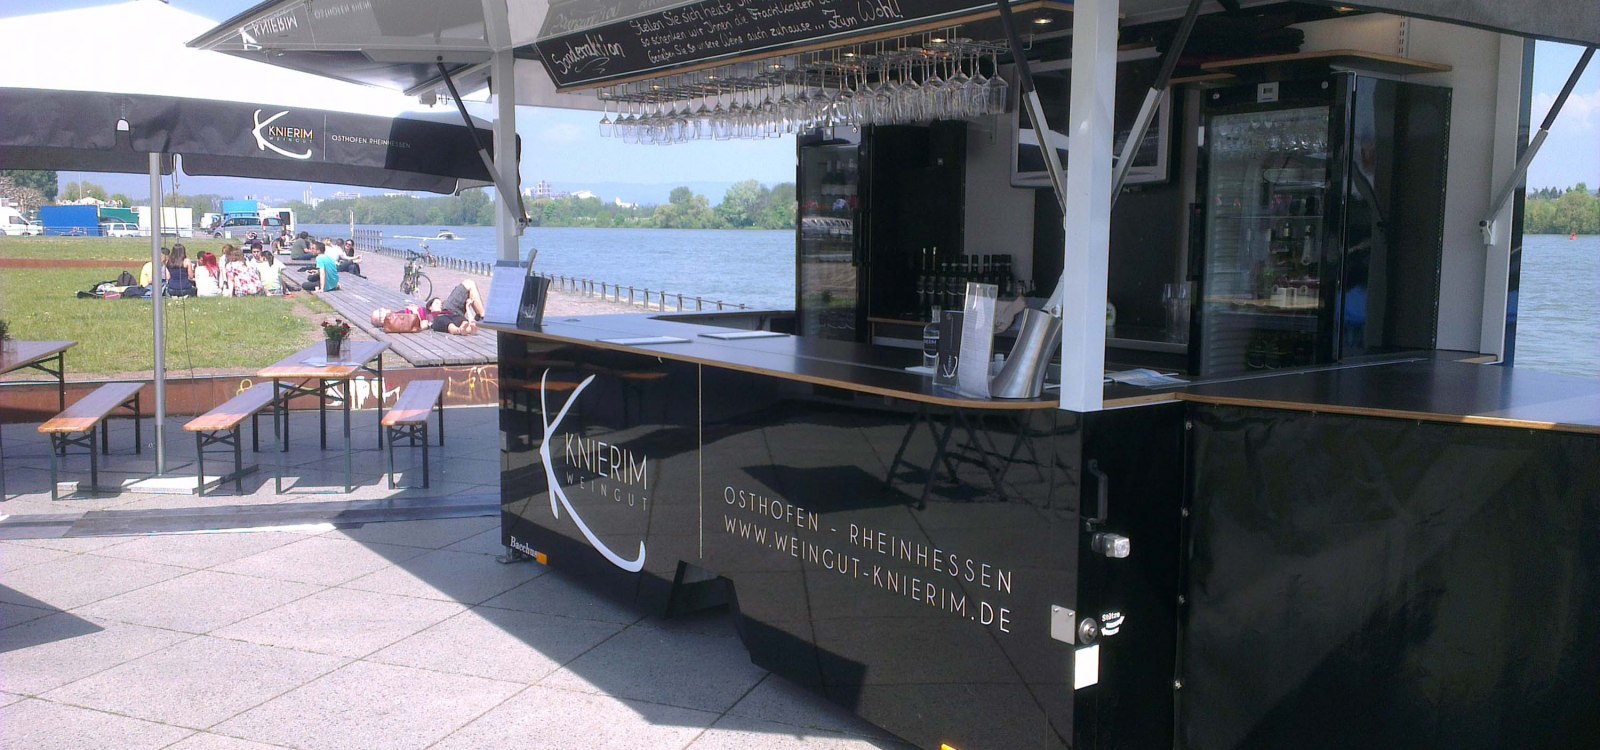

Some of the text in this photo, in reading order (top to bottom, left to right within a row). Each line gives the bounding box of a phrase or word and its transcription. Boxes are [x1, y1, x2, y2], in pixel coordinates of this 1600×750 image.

[630, 18, 664, 35] Stellen
[663, 11, 682, 26] Sie
[682, 6, 703, 23] sich
[702, 0, 735, 17] heute
[641, 37, 650, 47] so
[651, 30, 687, 46] schenken
[688, 26, 704, 38] wir
[734, 13, 749, 26] die
[748, 0, 815, 20] Frachtkosten
[675, 44, 688, 56] Sie
[746, 27, 769, 41] auch
[822, 9, 857, 29] Zum
[857, 0, 904, 22] Wohl!
[551, 33, 627, 75] Sonderaktion
[268, 126, 314, 139] KNIERIM
[269, 136, 313, 144] WEINGUT
[331, 135, 411, 148] OSTHOFEN RHEINHESSEN
[565, 432, 647, 490] KNIERIM
[566, 472, 647, 511] WEINGUT
[510, 535, 538, 558] Bacchus
[724, 486, 819, 532] OSTHOFEN
[850, 523, 1012, 595] RHEINHESSEN
[724, 514, 1011, 633] WWW.WEINGUT-KNIERIM.DE
